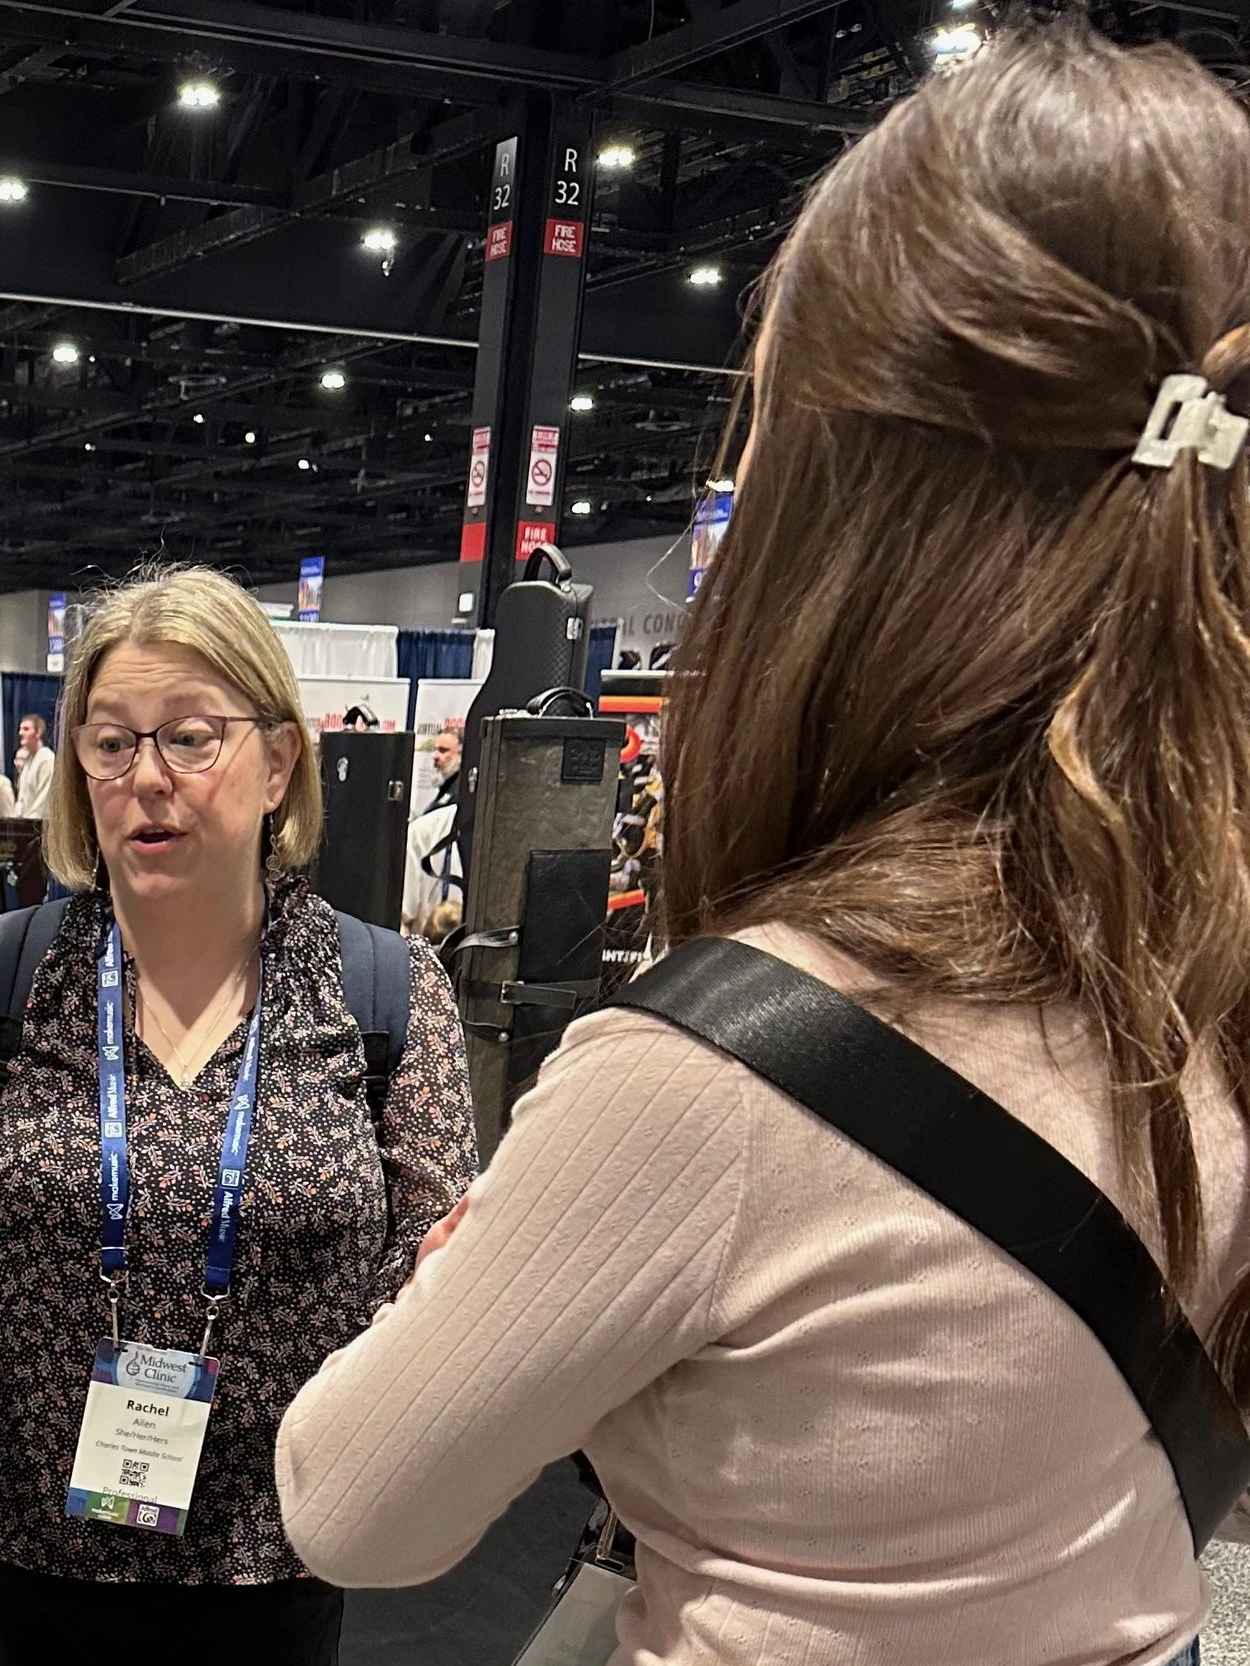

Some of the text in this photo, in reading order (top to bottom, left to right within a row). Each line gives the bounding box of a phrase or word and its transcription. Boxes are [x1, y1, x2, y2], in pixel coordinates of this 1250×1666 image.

[500, 153, 510, 177] R
[564, 148, 578, 173] R
[493, 184, 510, 211] 32
[554, 180, 580, 206] 32
[492, 227, 507, 243] FIRE
[554, 224, 576, 239] FIRE
[551, 238, 577, 253] HOSE
[524, 526, 547, 540] FIRE
[520, 539, 547, 553] HO
[107, 1094, 119, 1119] Alfred
[108, 1151, 119, 1201] makemusic
[221, 1190, 233, 1219] Alfred
[139, 1354, 187, 1373] Midwest
[144, 1368, 176, 1383] Clinic
[126, 1399, 170, 1417] Rachel
[102, 1486, 158, 1504] Professional
